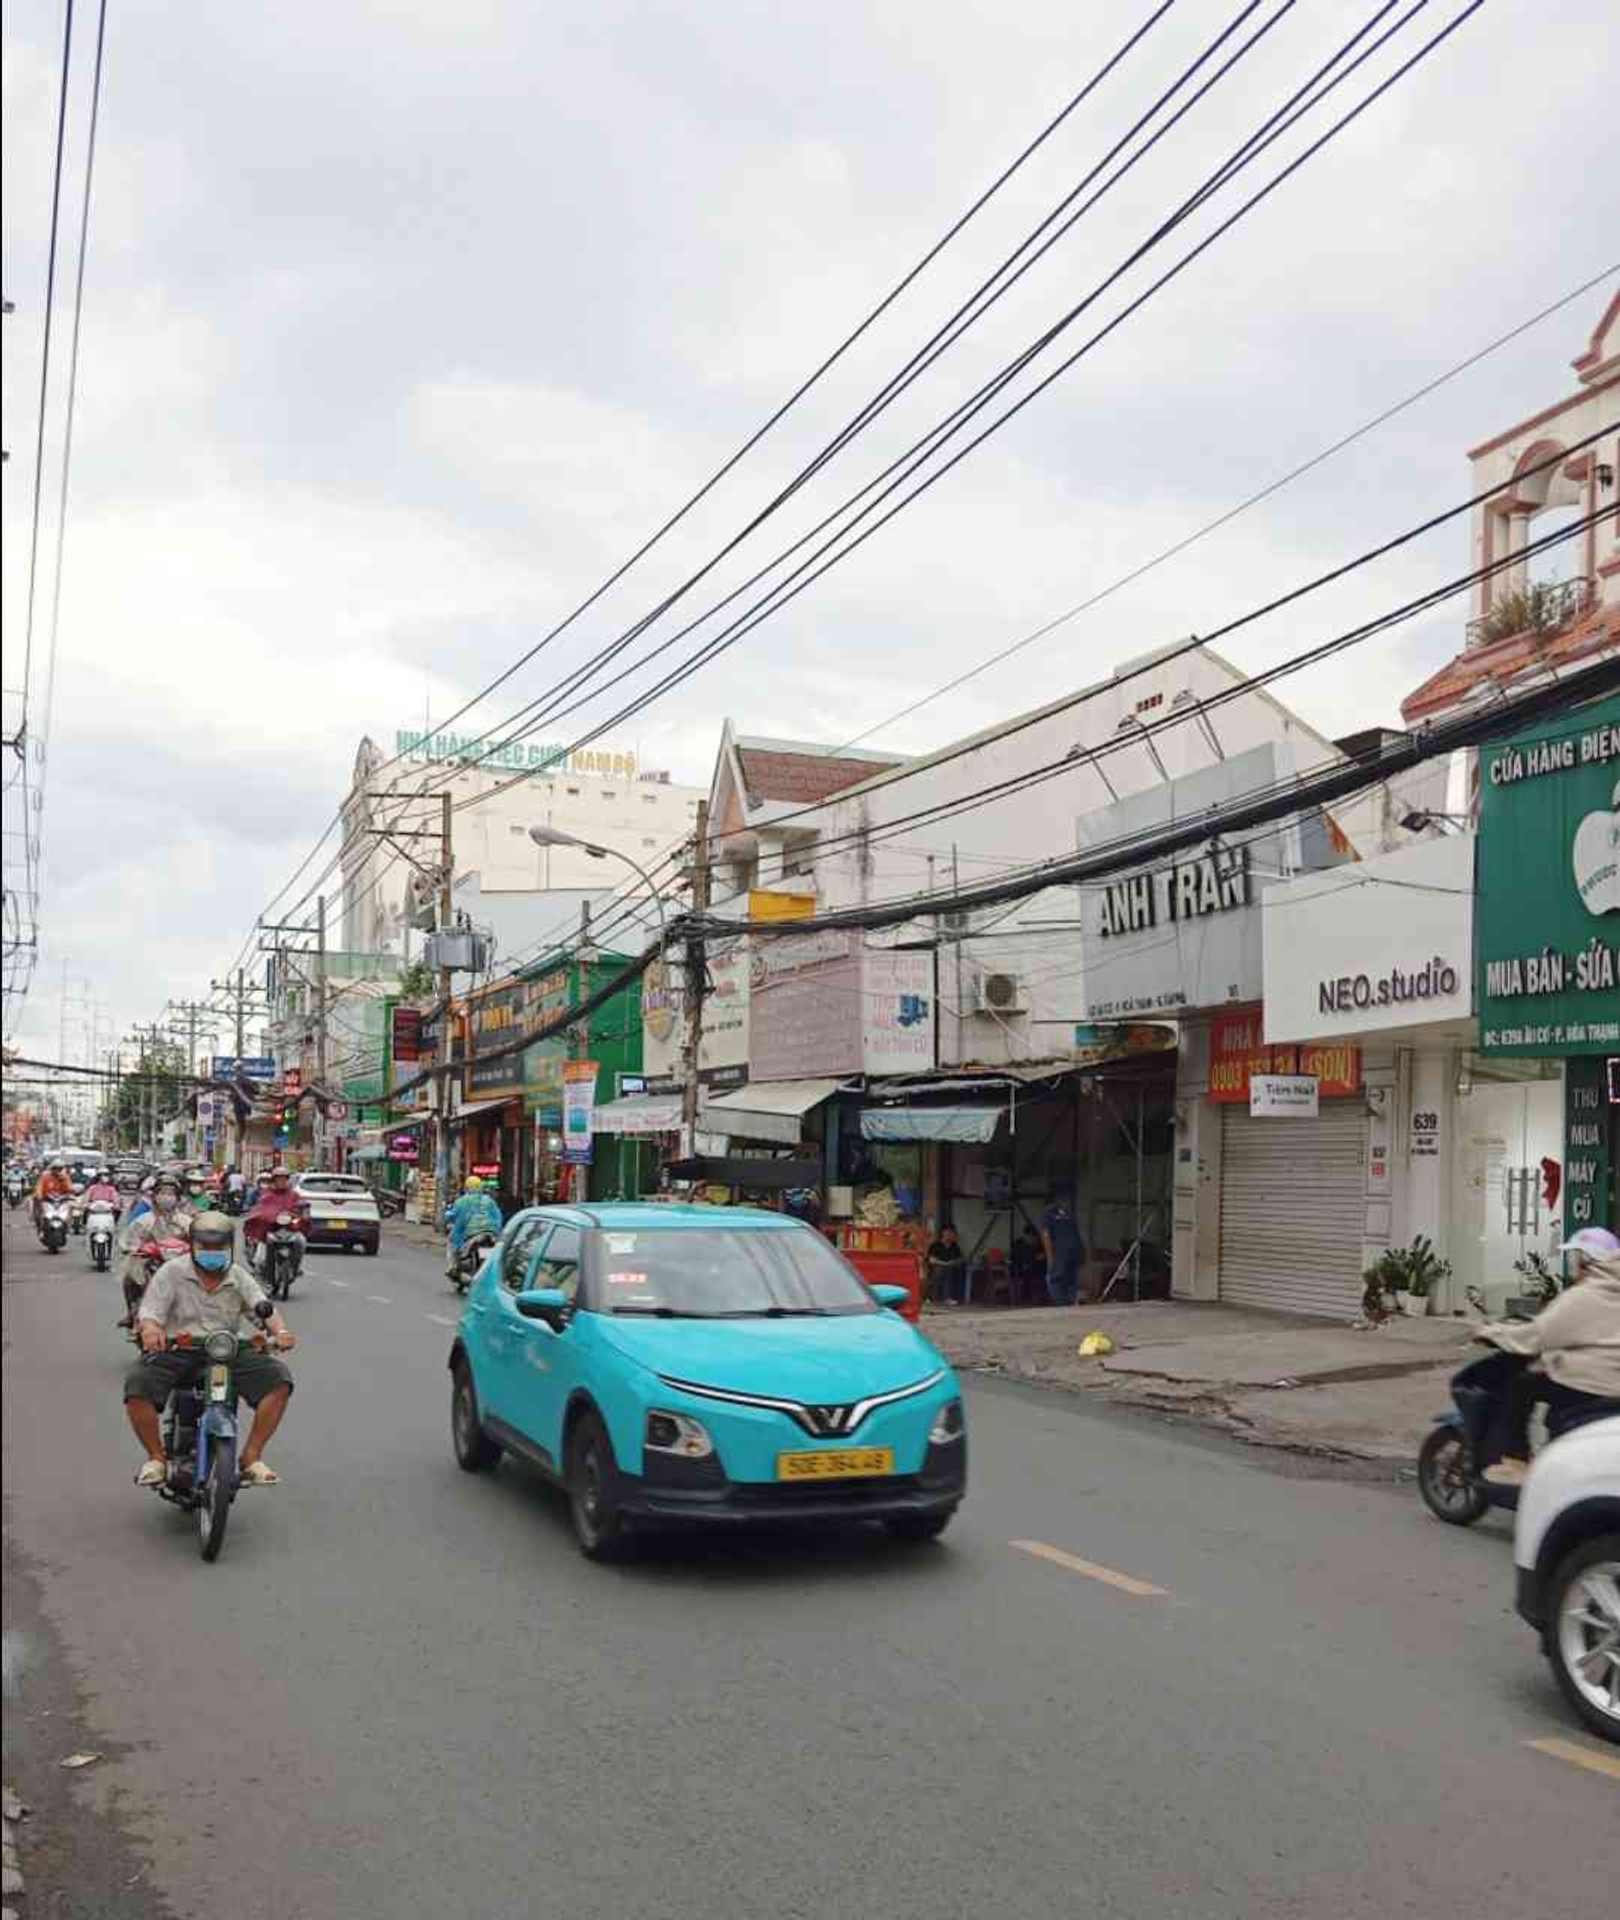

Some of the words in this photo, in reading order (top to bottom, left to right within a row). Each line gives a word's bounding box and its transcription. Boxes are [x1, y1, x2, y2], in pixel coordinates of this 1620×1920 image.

[1526, 741, 1575, 776] HÀNG
[1102, 874, 1154, 938] ANH
[1487, 959, 1523, 997] MUA
[1526, 947, 1563, 994] BÁN
[1576, 935, 1613, 989] SỬA
[1319, 955, 1457, 1013] NEO.studio
[1573, 1089, 1598, 1108] THU
[1414, 1113, 1437, 1130] 639
[1571, 1124, 1599, 1145] MUA
[1568, 1156, 1597, 1183] MÁY
[1573, 1193, 1592, 1219] CŨ
